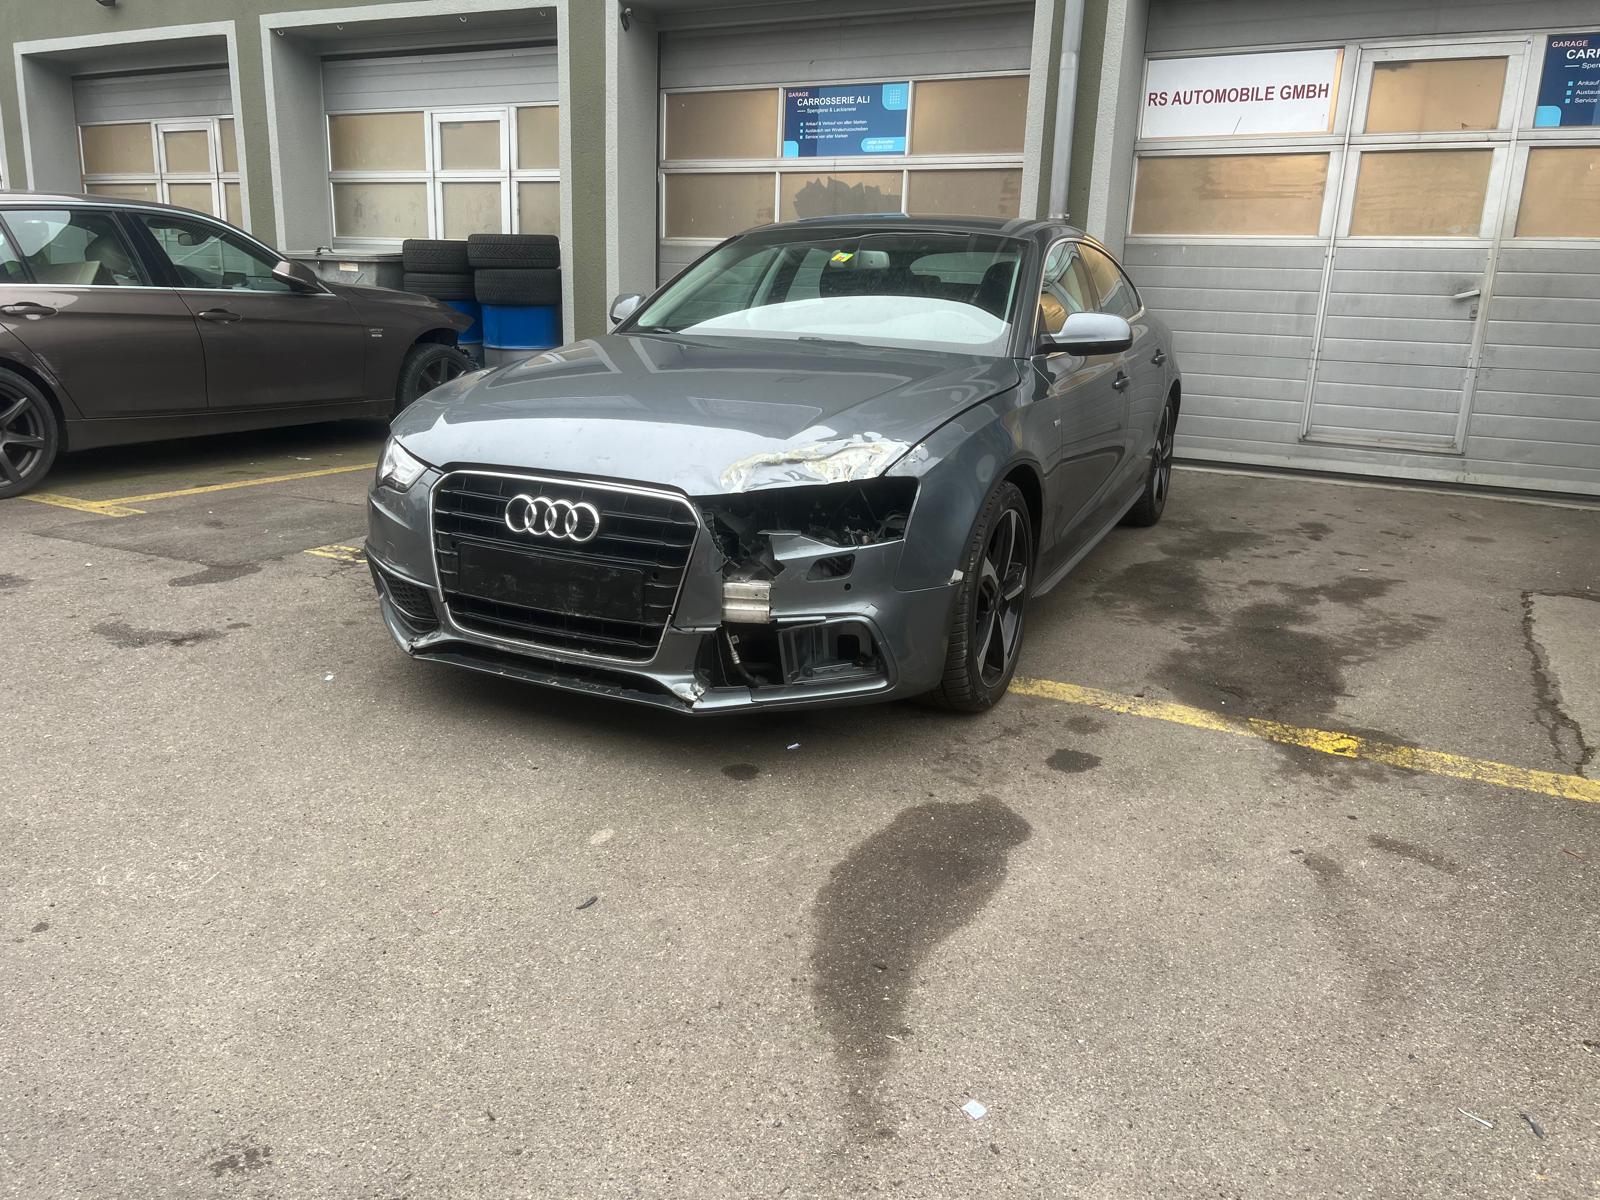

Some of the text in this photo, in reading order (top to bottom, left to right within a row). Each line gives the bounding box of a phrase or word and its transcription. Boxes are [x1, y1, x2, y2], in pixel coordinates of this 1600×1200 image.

[797, 96, 854, 106] CARROSSERIE
[1148, 83, 1330, 106] RS AUTOMOBILE GMBH
